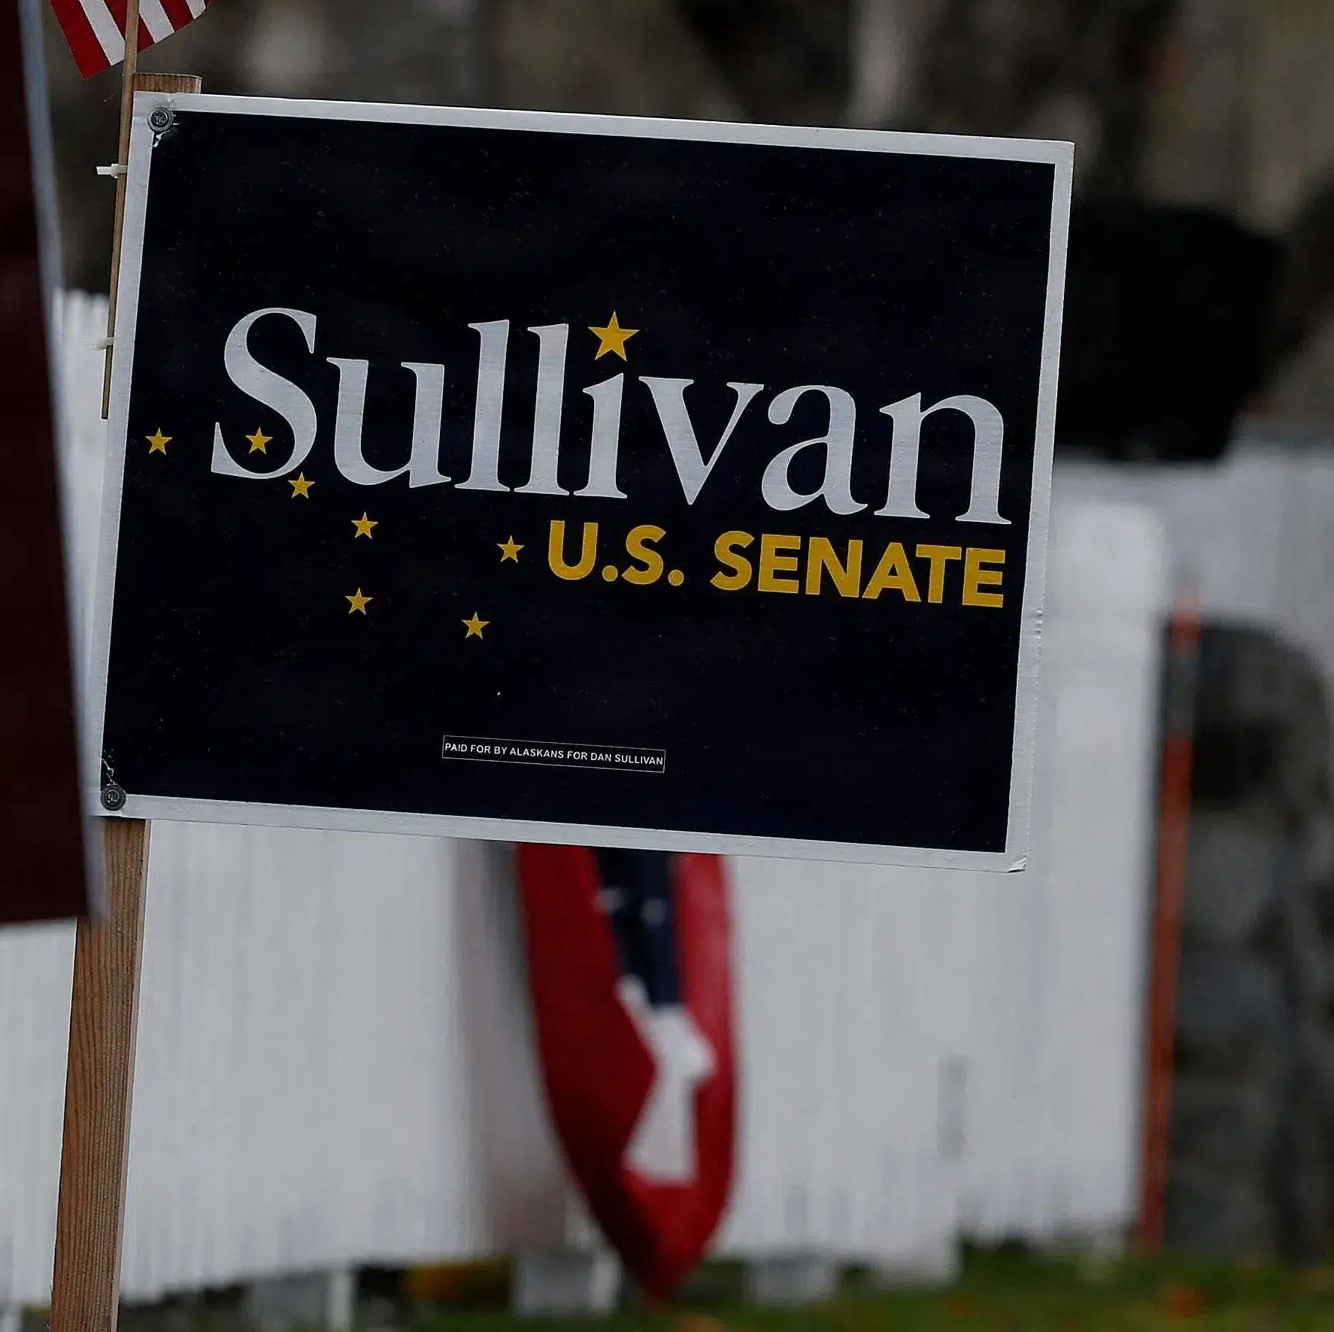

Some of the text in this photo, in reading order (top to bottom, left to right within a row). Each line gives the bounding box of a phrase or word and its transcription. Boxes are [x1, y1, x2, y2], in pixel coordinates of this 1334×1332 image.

[210, 307, 1013, 526] Sullivan
[547, 519, 1006, 609] U.S. SENATE
[444, 742, 664, 766] PAID FOR BY ALASKANS FOR DAN SULLIVAN
